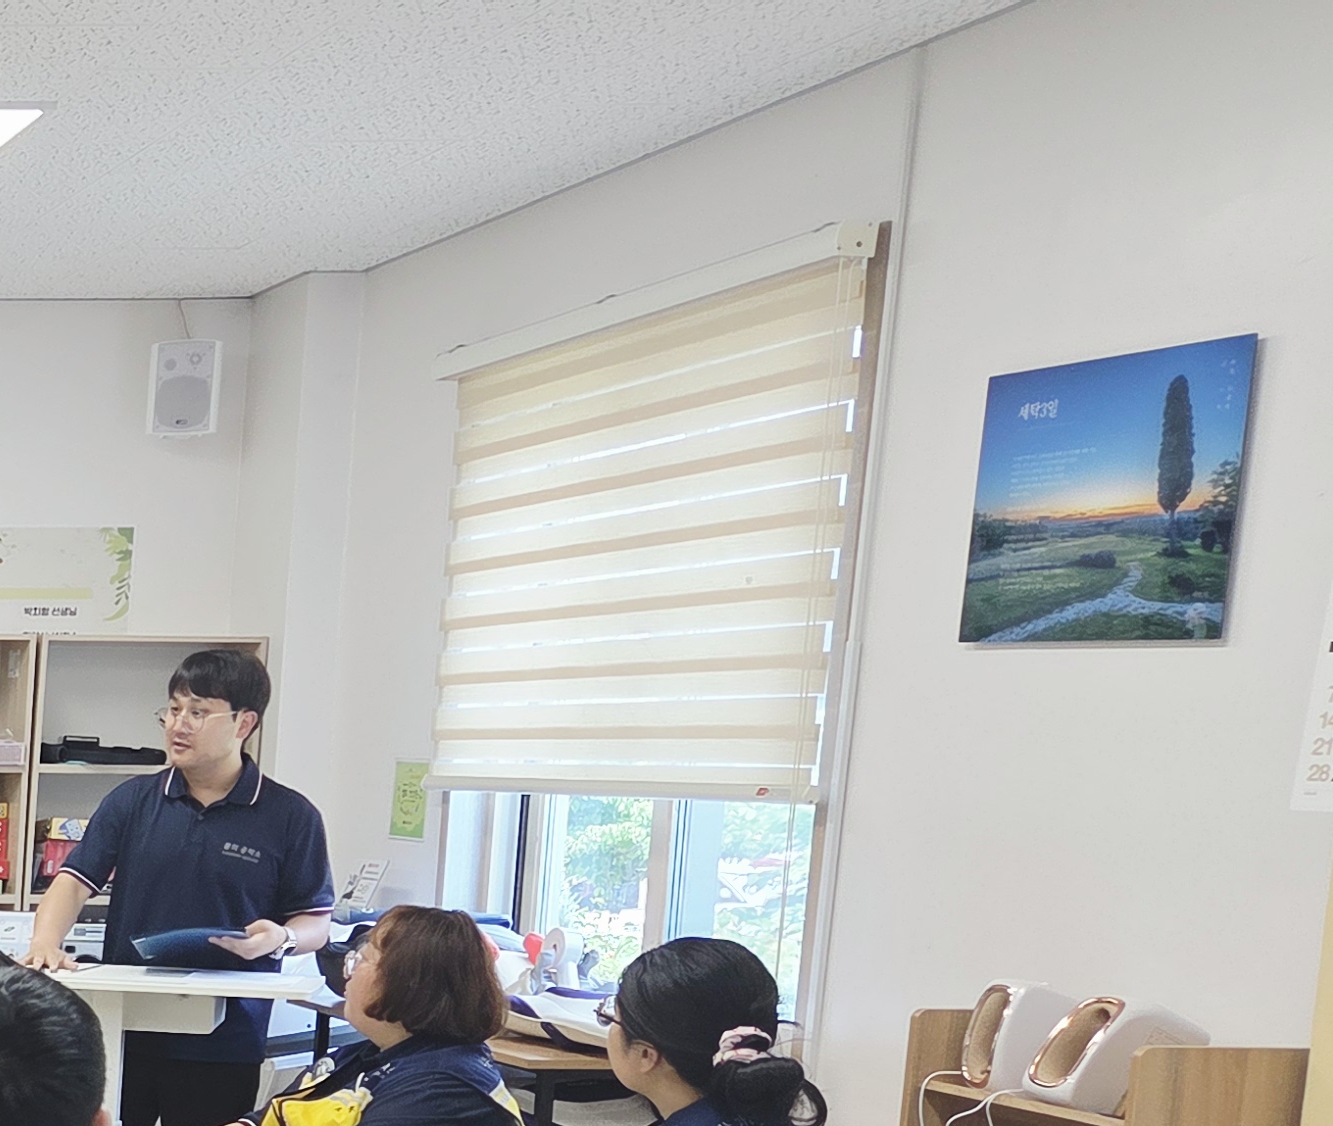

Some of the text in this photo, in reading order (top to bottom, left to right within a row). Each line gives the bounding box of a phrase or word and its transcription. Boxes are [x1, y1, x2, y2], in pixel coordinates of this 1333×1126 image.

[52, 606, 77, 617] 선생님
[1311, 737, 1333, 756] 21
[1306, 764, 1331, 782] 28
